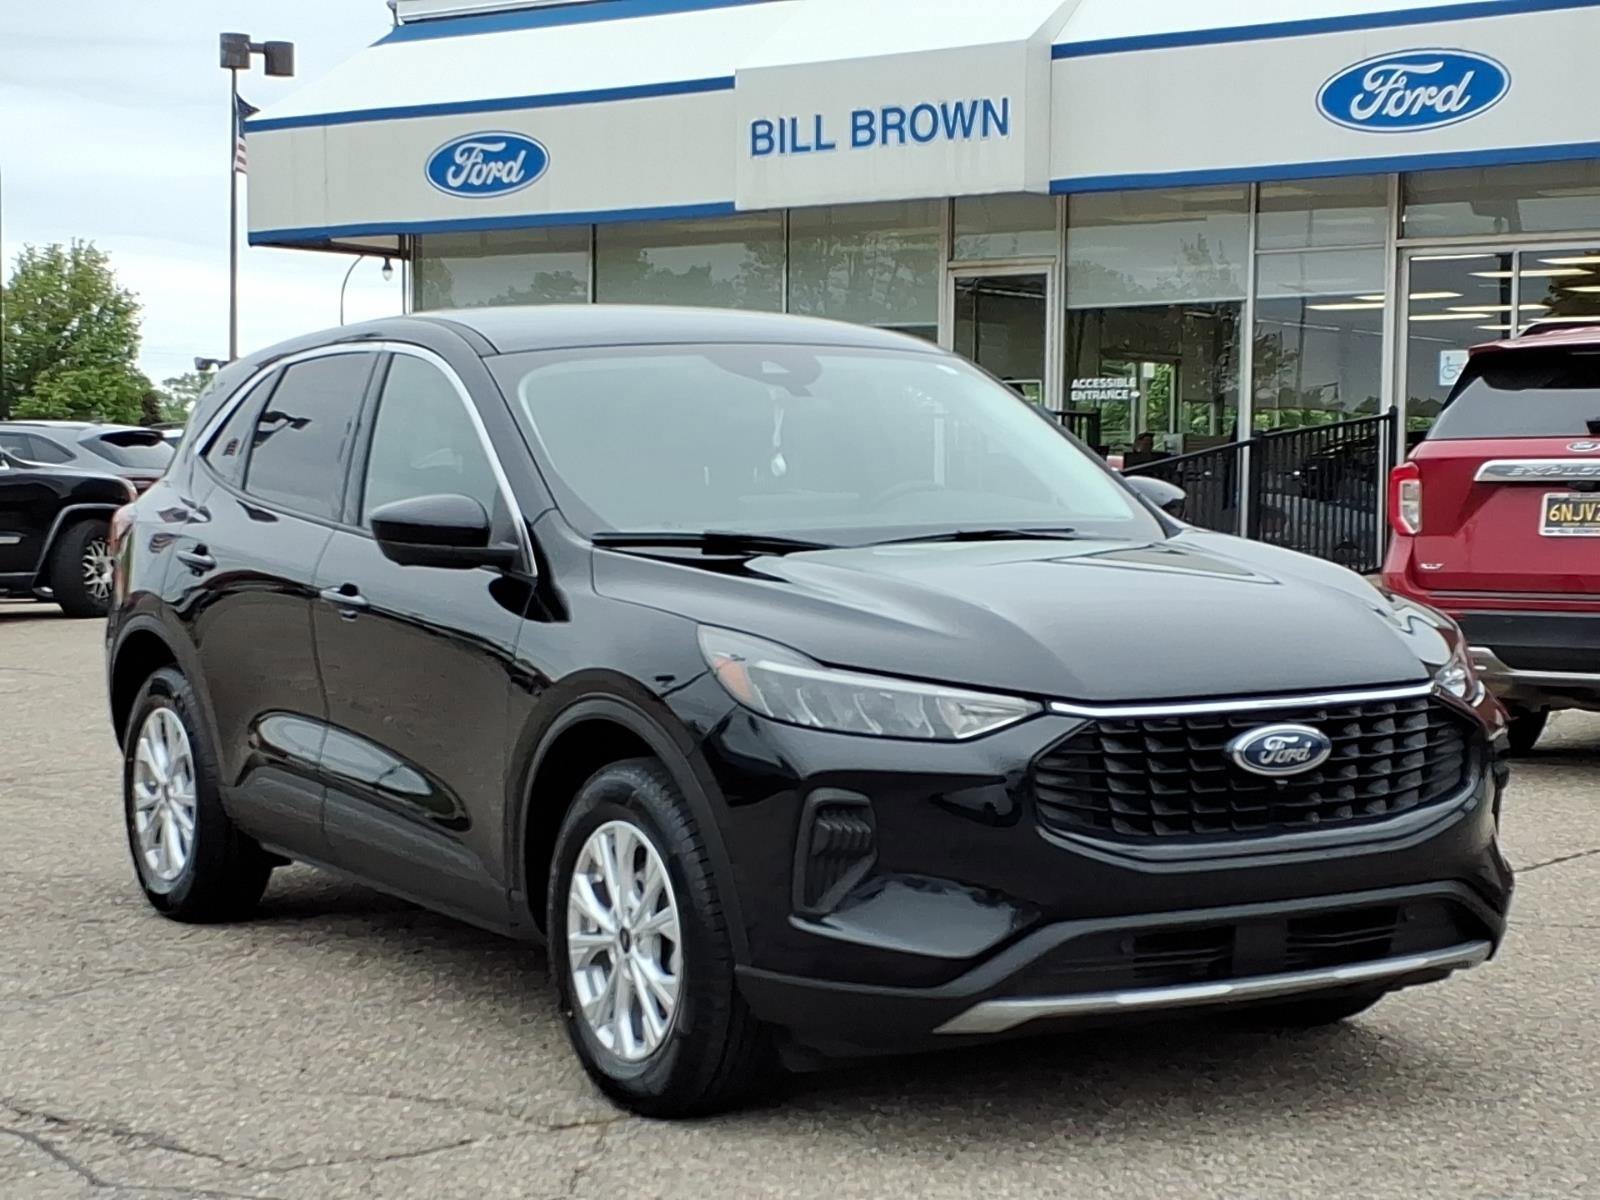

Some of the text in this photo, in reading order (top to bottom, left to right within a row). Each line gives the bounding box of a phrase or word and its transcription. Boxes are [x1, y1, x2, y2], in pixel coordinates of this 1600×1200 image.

[1350, 61, 1475, 121] Ford
[751, 97, 1009, 156] BILL BROWN
[447, 142, 526, 188] Ford
[1071, 377, 1137, 389] ACCESSIBLE
[1071, 389, 1129, 401] ENTRANCE
[1506, 465, 1600, 476] EXPLO
[1258, 735, 1312, 764] Ford
